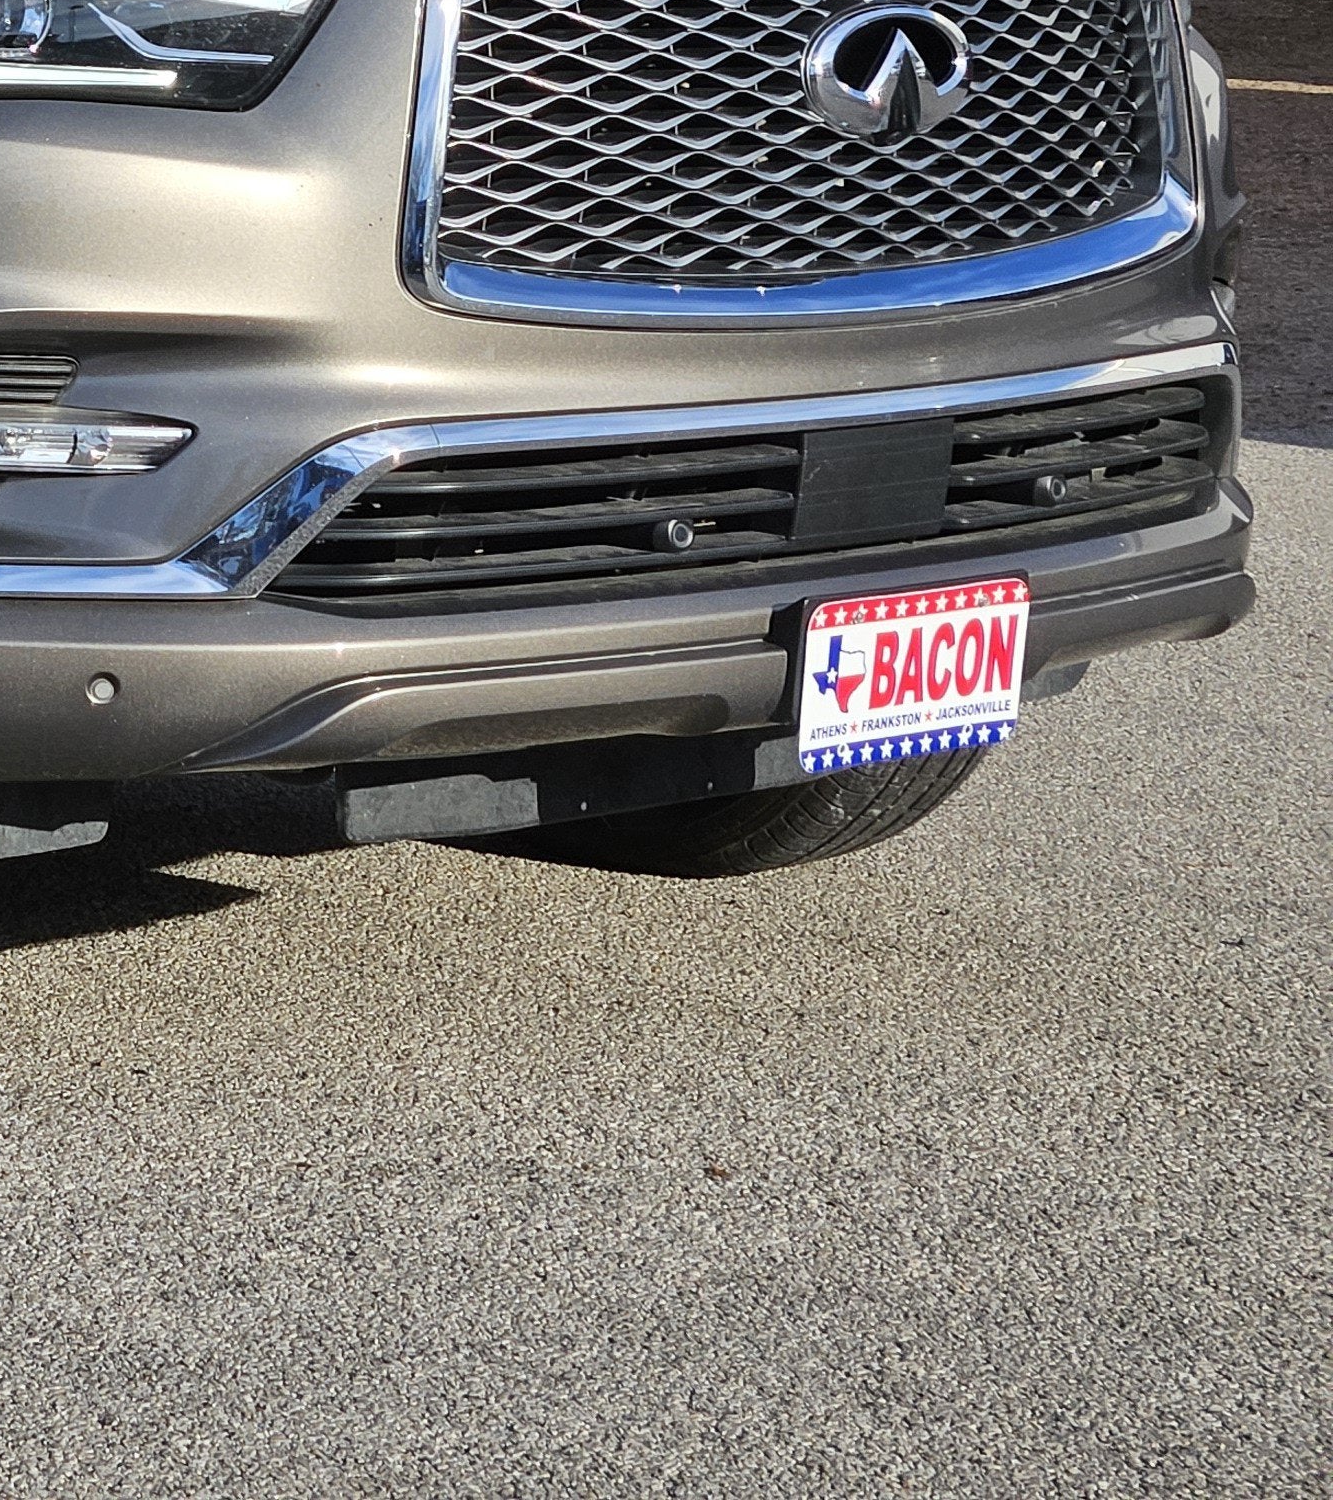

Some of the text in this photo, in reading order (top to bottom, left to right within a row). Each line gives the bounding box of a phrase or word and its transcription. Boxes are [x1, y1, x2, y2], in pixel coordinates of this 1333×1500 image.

[868, 613, 1019, 710] BACON
[809, 700, 1012, 741] ATHENS FRANKSTON JACKSONVILLE
